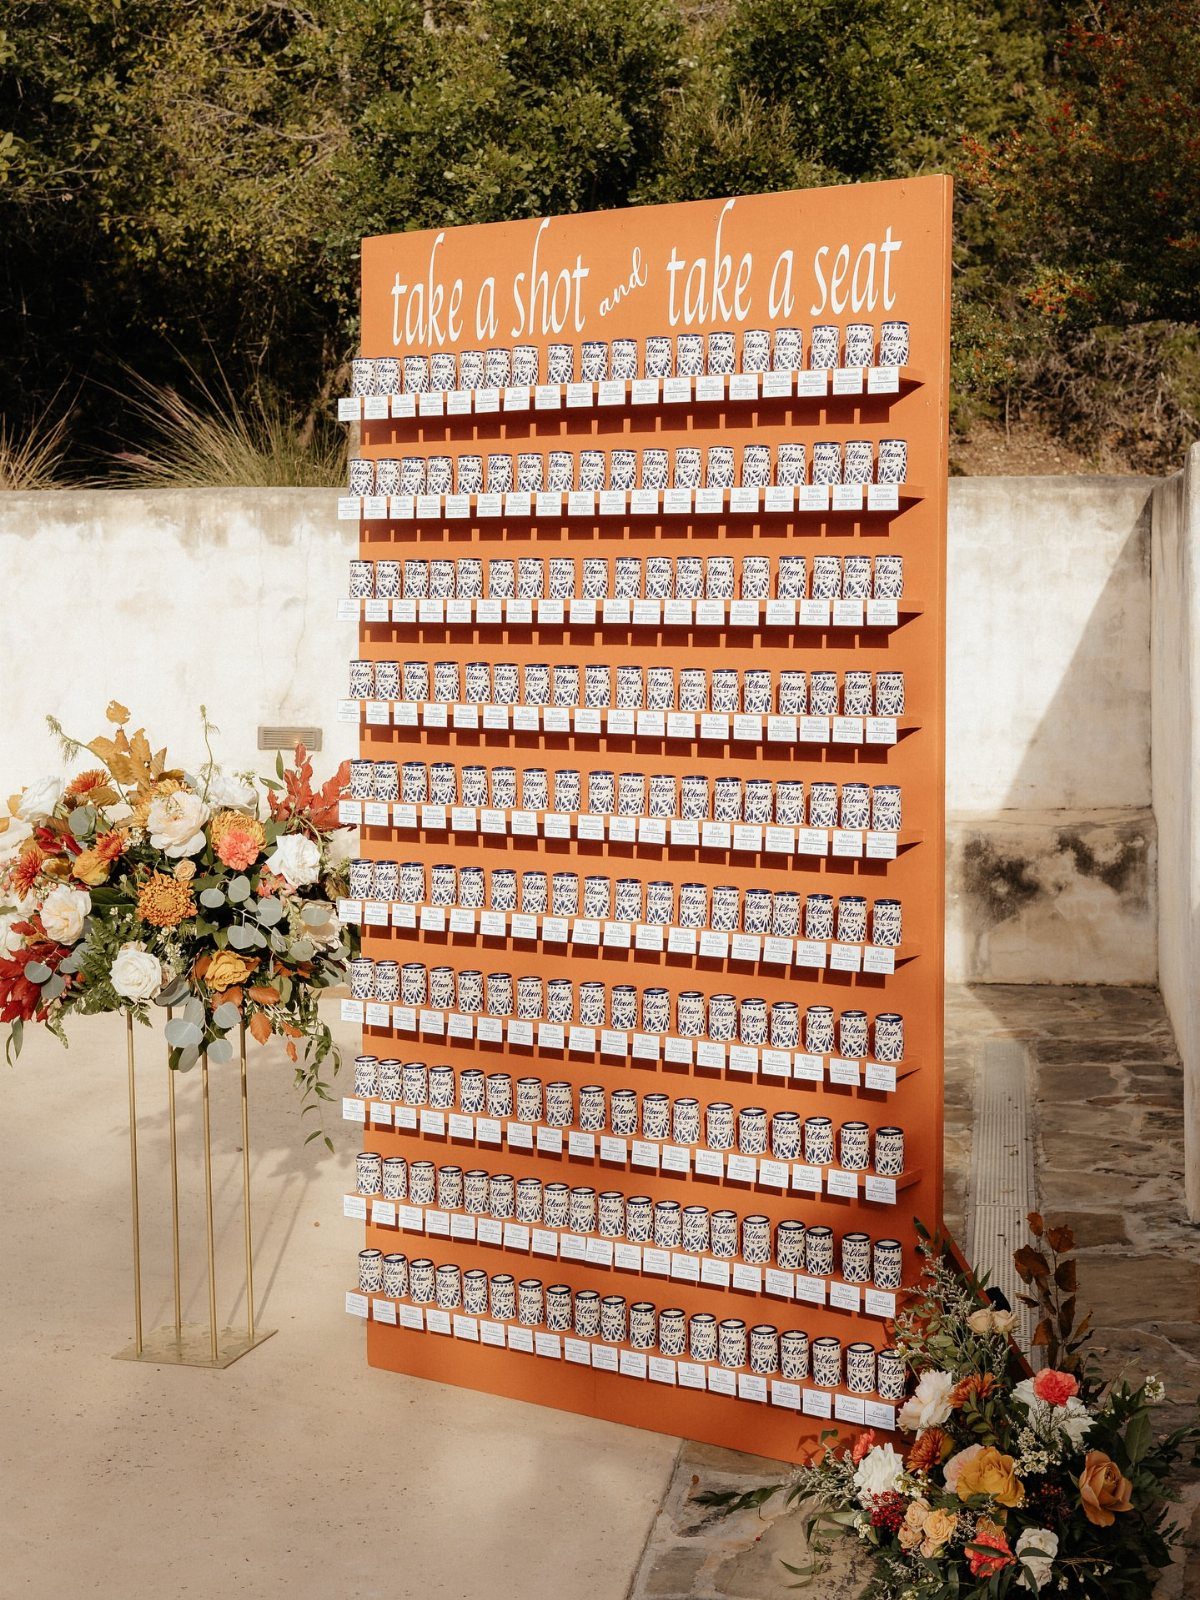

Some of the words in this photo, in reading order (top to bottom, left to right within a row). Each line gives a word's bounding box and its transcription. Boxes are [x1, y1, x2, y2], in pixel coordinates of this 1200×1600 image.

[391, 233, 463, 347] take
[476, 277, 498, 340] a
[511, 217, 589, 337] shot
[600, 247, 648, 317] and
[666, 199, 753, 326] take
[769, 250, 794, 319] a
[810, 227, 902, 316] seat
